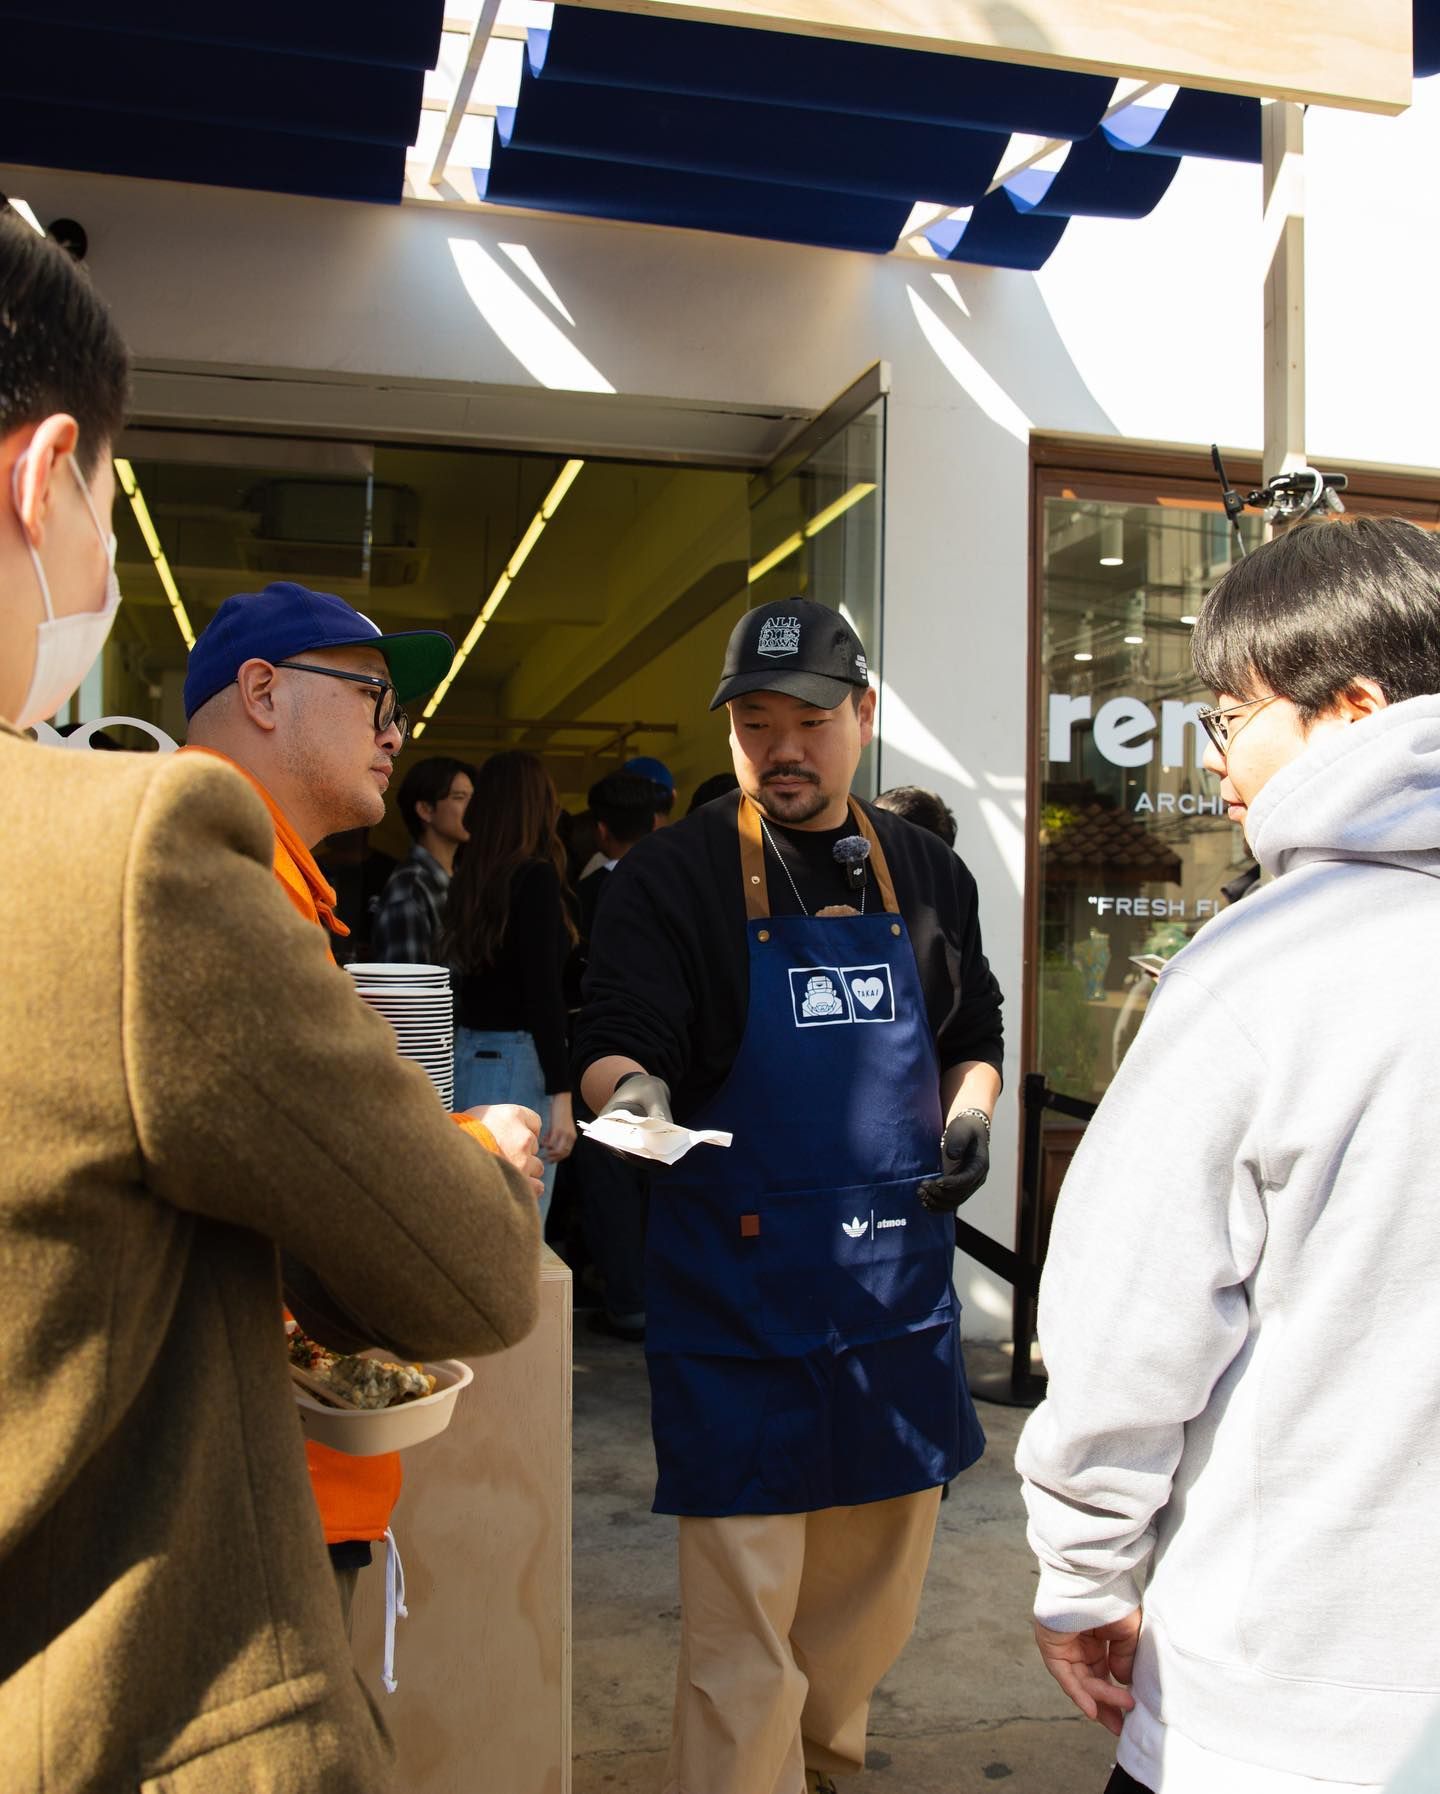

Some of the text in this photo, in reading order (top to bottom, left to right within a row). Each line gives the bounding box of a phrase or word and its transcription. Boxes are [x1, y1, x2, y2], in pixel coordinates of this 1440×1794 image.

[761, 616, 801, 628] ALL
[759, 638, 799, 648] DOWN
[876, 1218, 907, 1228] atmos
